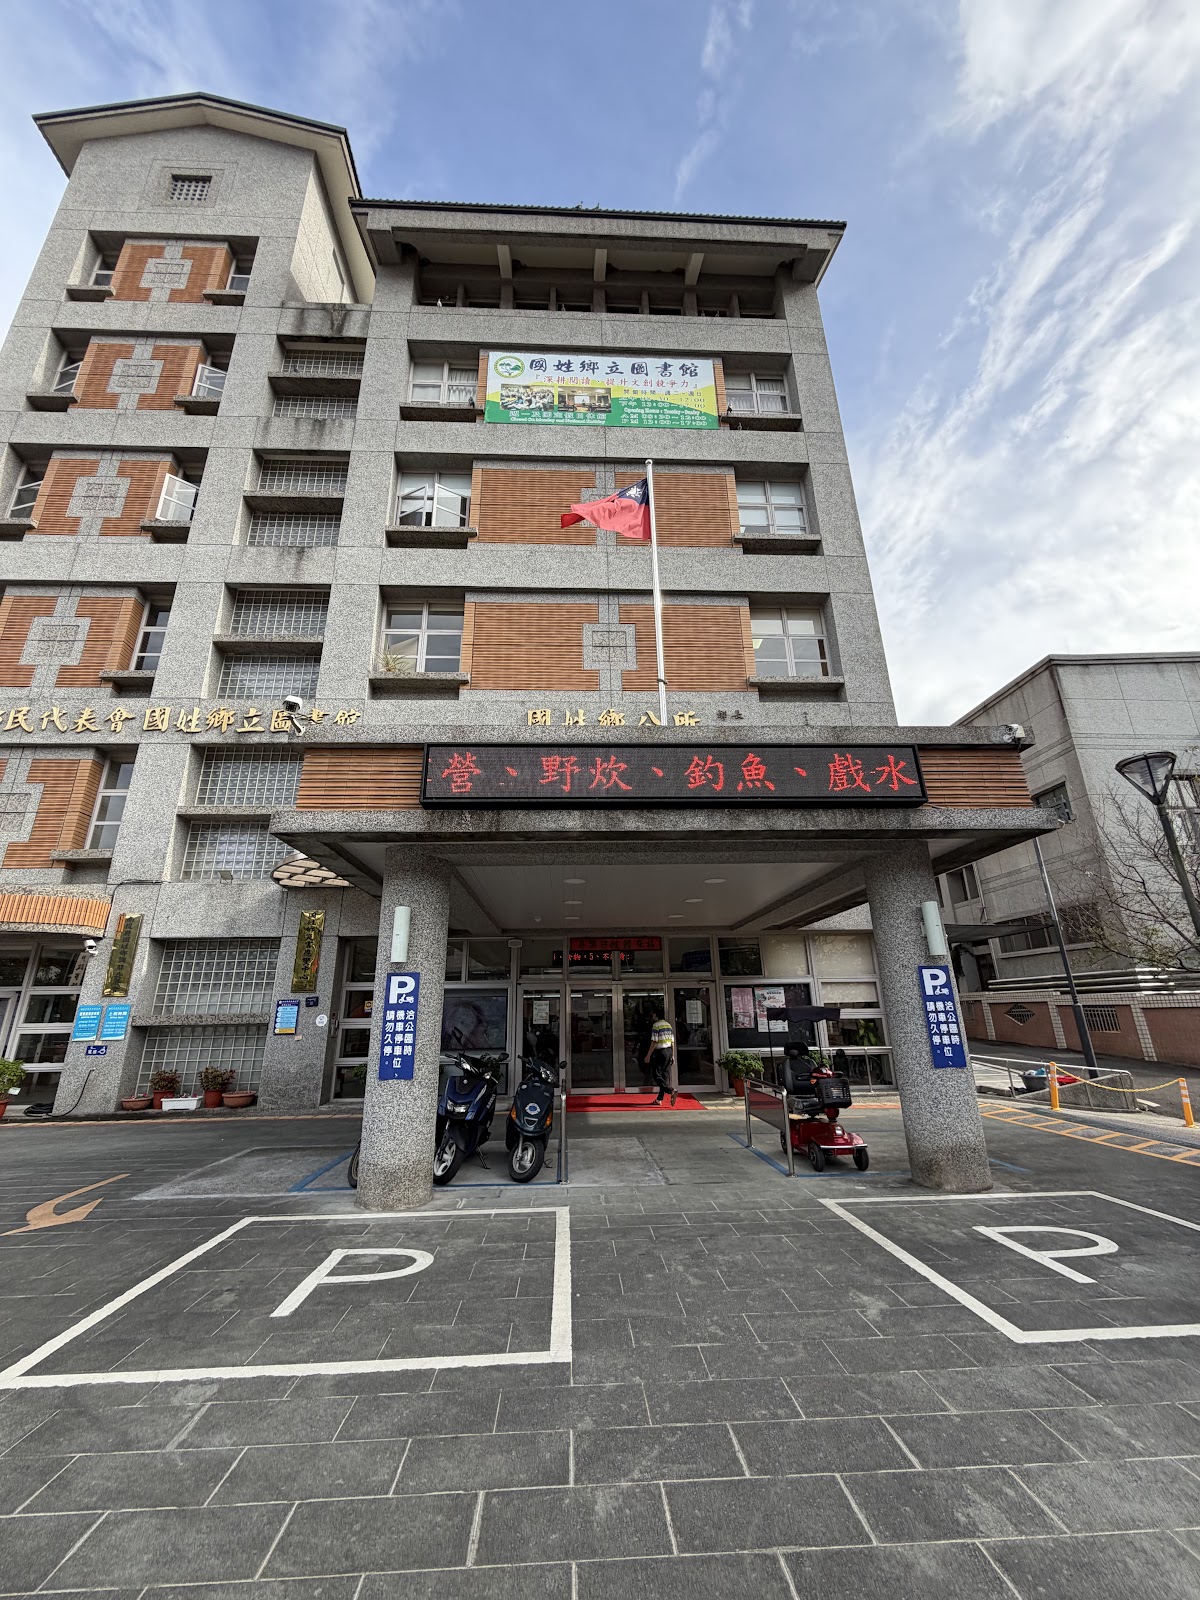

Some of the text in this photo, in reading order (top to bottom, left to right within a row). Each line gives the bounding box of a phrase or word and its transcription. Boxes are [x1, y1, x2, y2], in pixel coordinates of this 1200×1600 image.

[529, 357, 699, 378] 國姓鄉立圖書館
[389, 975, 415, 1004] P
[922, 968, 947, 996] P
[403, 1009, 415, 1056] 洽公臨時
[945, 1001, 960, 1046] 洽公臨時
[972, 1225, 1119, 1284] P
[269, 1247, 434, 1317] P
